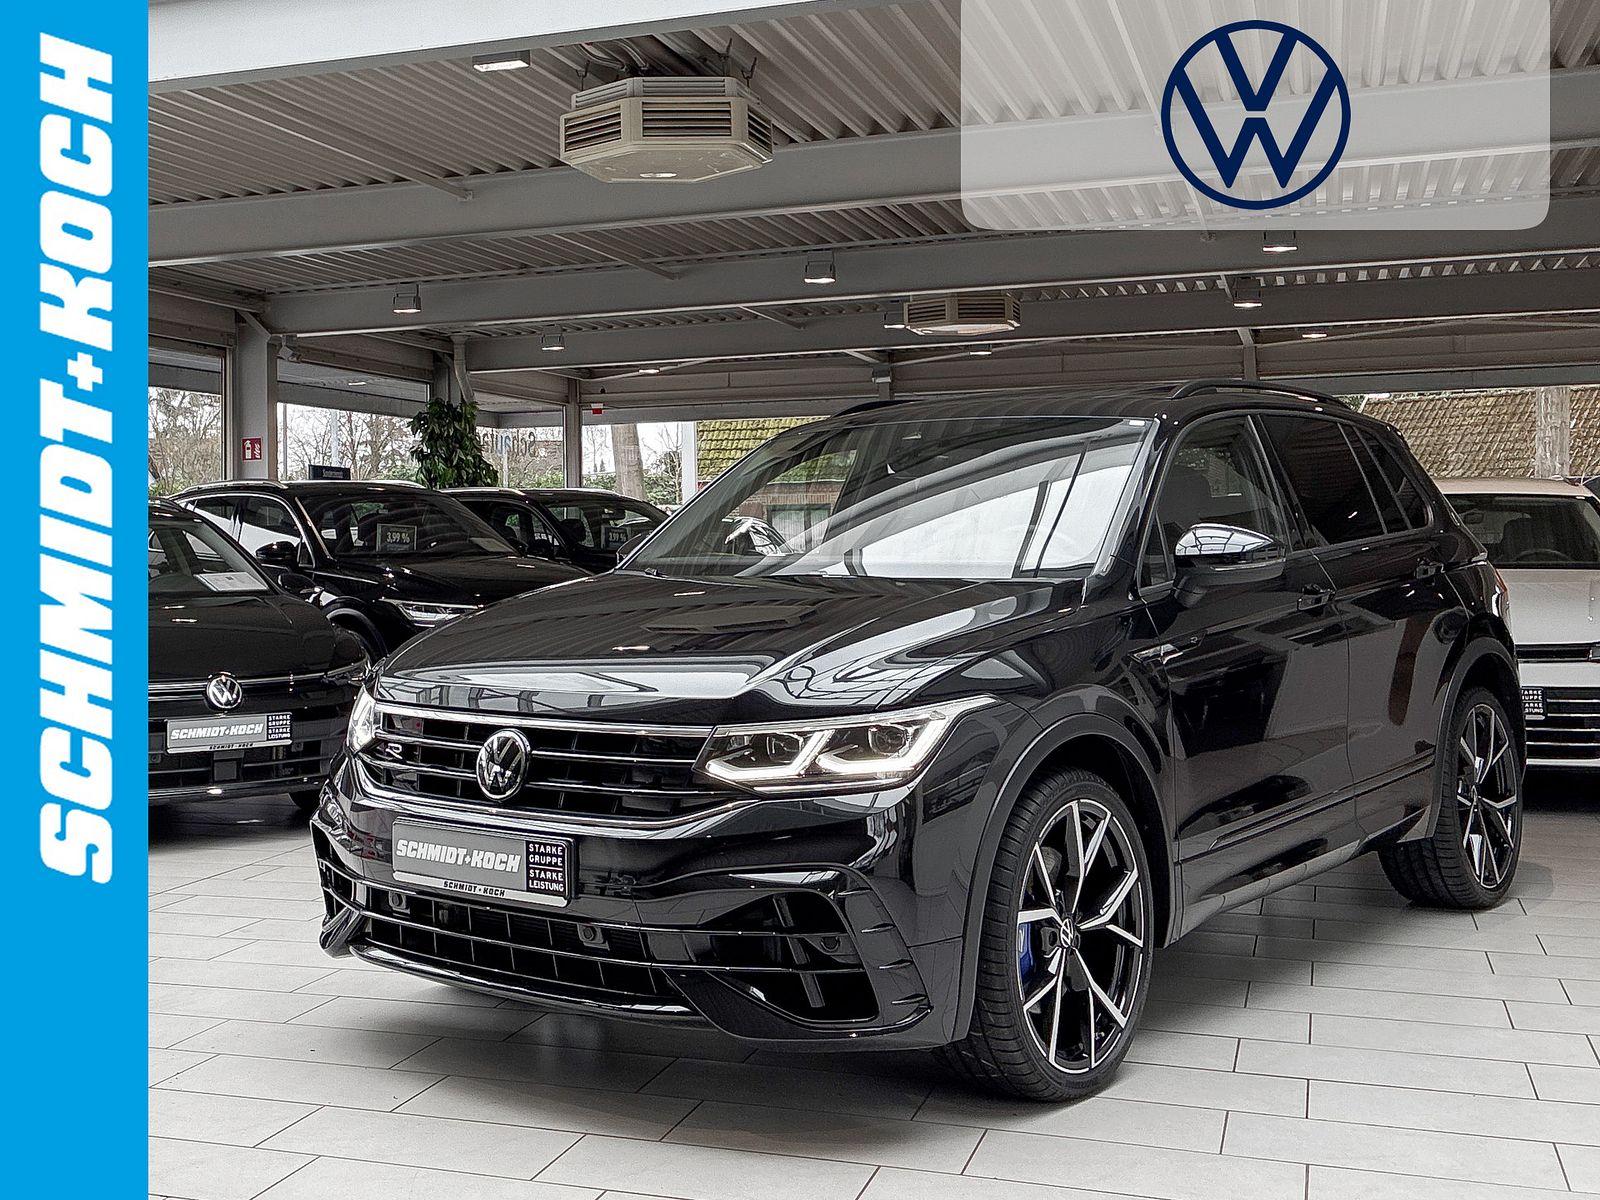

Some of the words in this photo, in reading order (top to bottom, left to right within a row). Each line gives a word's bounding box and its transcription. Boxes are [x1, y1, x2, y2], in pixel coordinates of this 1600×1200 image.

[528, 843, 563, 856] STARKE
[528, 854, 563, 866] GRUPPE
[528, 869, 564, 881] STARKE
[528, 879, 565, 892] LEISTUNG
